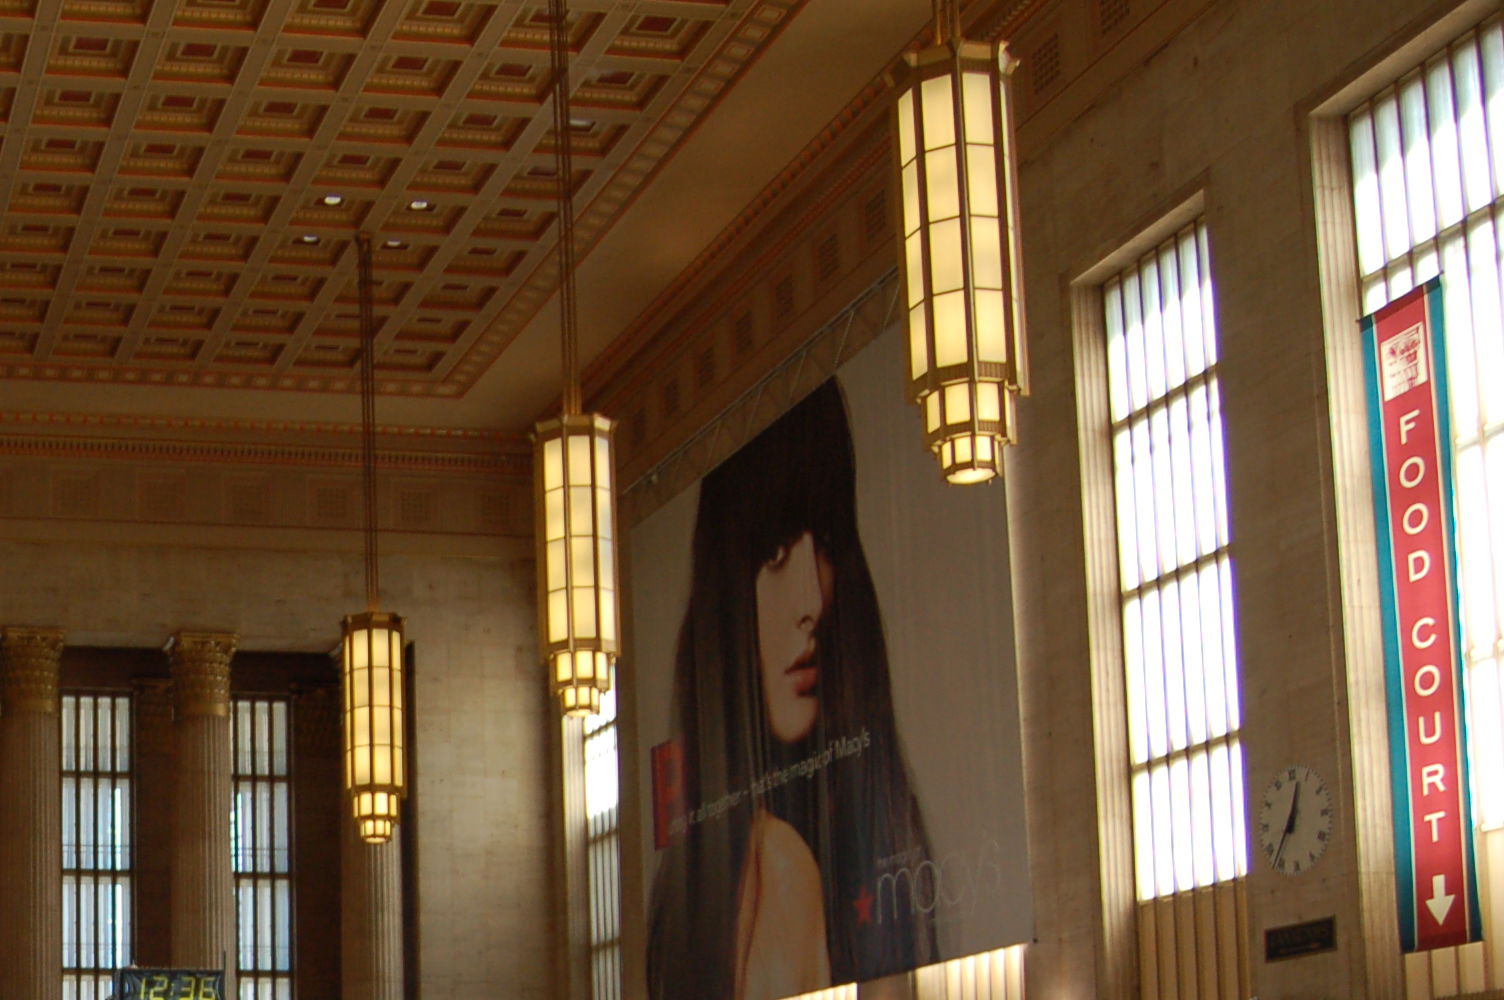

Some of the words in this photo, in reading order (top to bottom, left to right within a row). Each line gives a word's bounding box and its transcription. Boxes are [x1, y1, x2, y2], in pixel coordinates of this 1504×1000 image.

[1399, 411, 1430, 582] FOOD
[835, 727, 870, 760] Macy's
[1411, 617, 1445, 844] COURT
